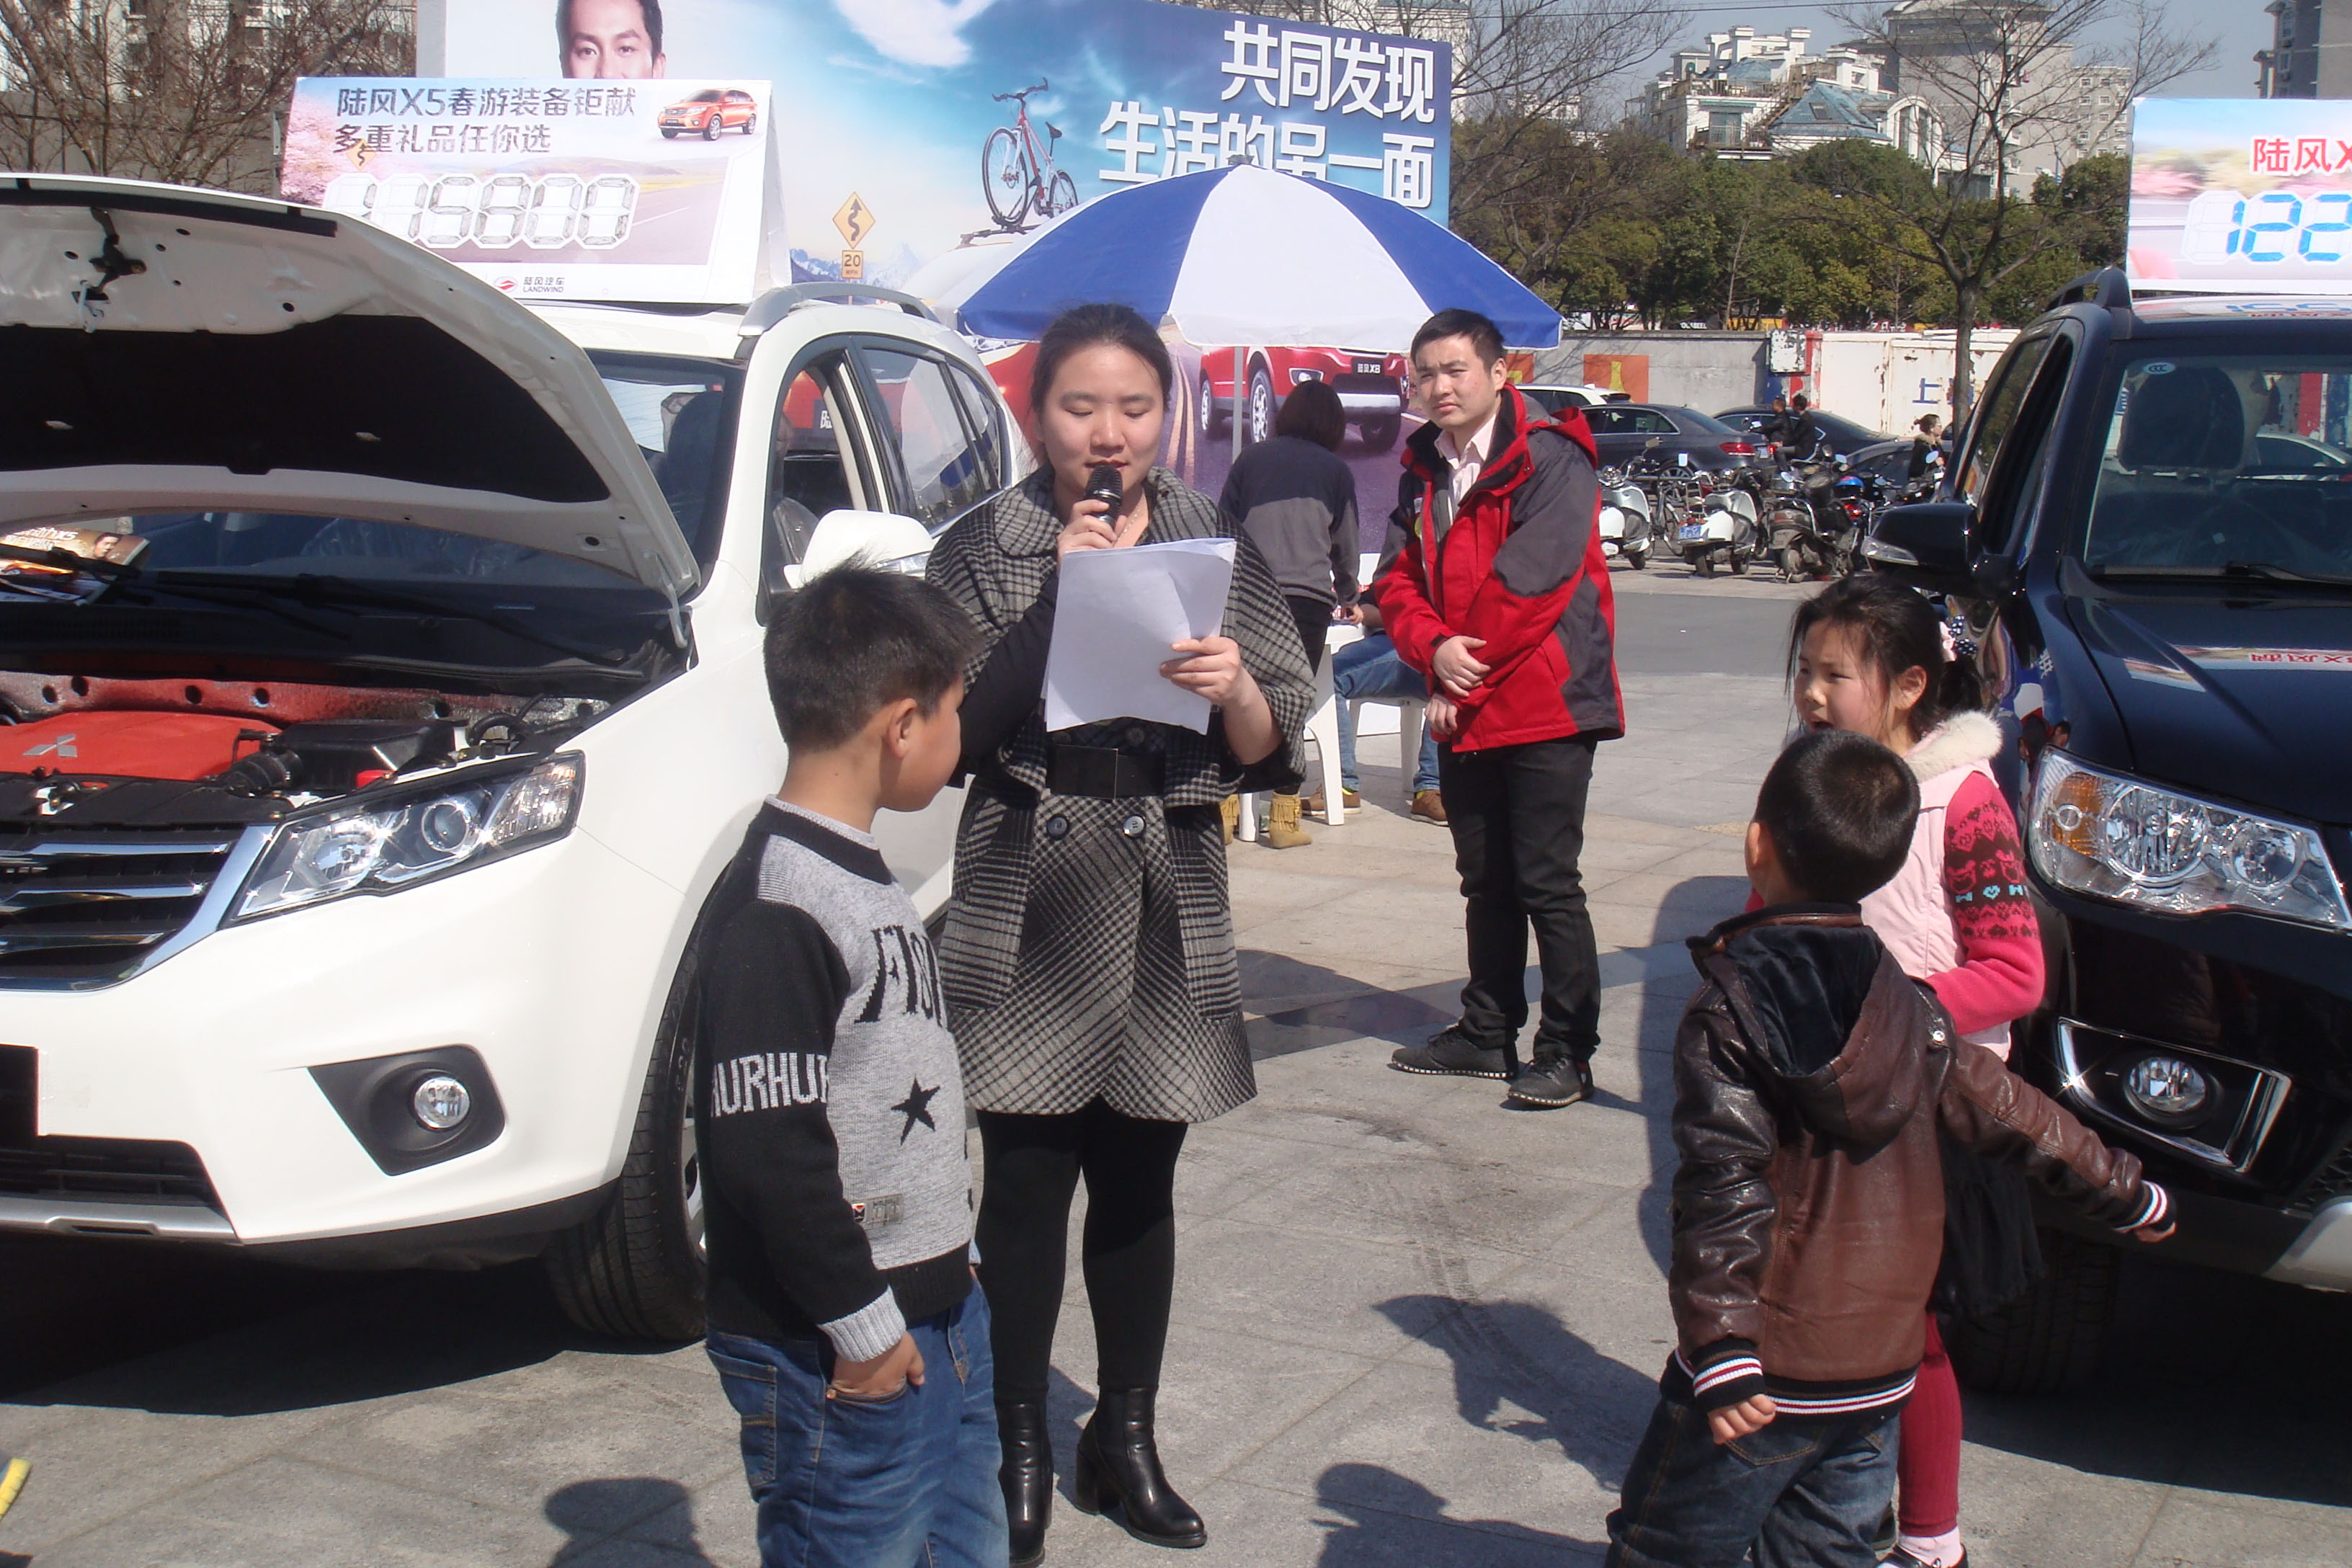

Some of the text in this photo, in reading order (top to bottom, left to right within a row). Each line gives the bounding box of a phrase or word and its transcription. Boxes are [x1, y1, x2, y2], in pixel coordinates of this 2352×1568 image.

[1221, 20, 1435, 124] 共同发现
[337, 88, 636, 117] 陆风X5春游装备钜献
[334, 124, 551, 153] 多重礼品任你选
[1099, 100, 1435, 208] 生活的另一面
[844, 254, 861, 267] 20
[524, 277, 565, 285] 陆风汽车
